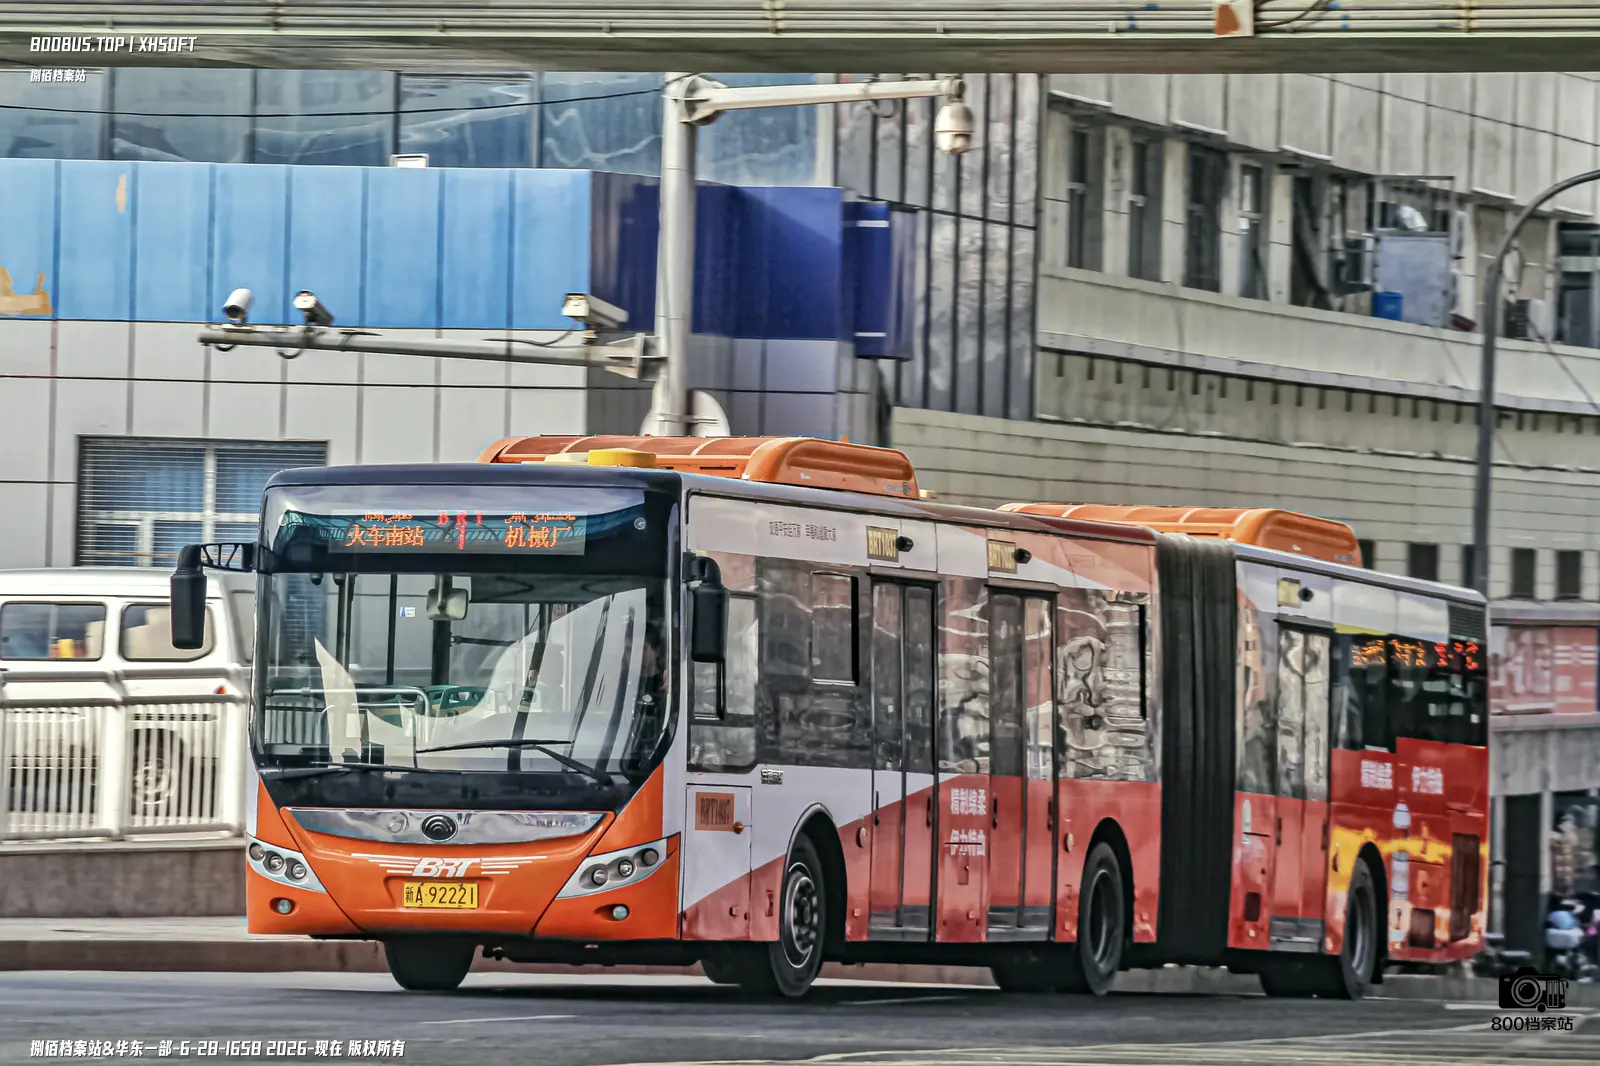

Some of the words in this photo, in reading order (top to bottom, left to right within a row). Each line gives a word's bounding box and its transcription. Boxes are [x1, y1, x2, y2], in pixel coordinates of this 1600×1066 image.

[345, 524, 424, 546] 火车南站
[504, 526, 572, 548] 机械厂
[412, 858, 481, 878] BRT
